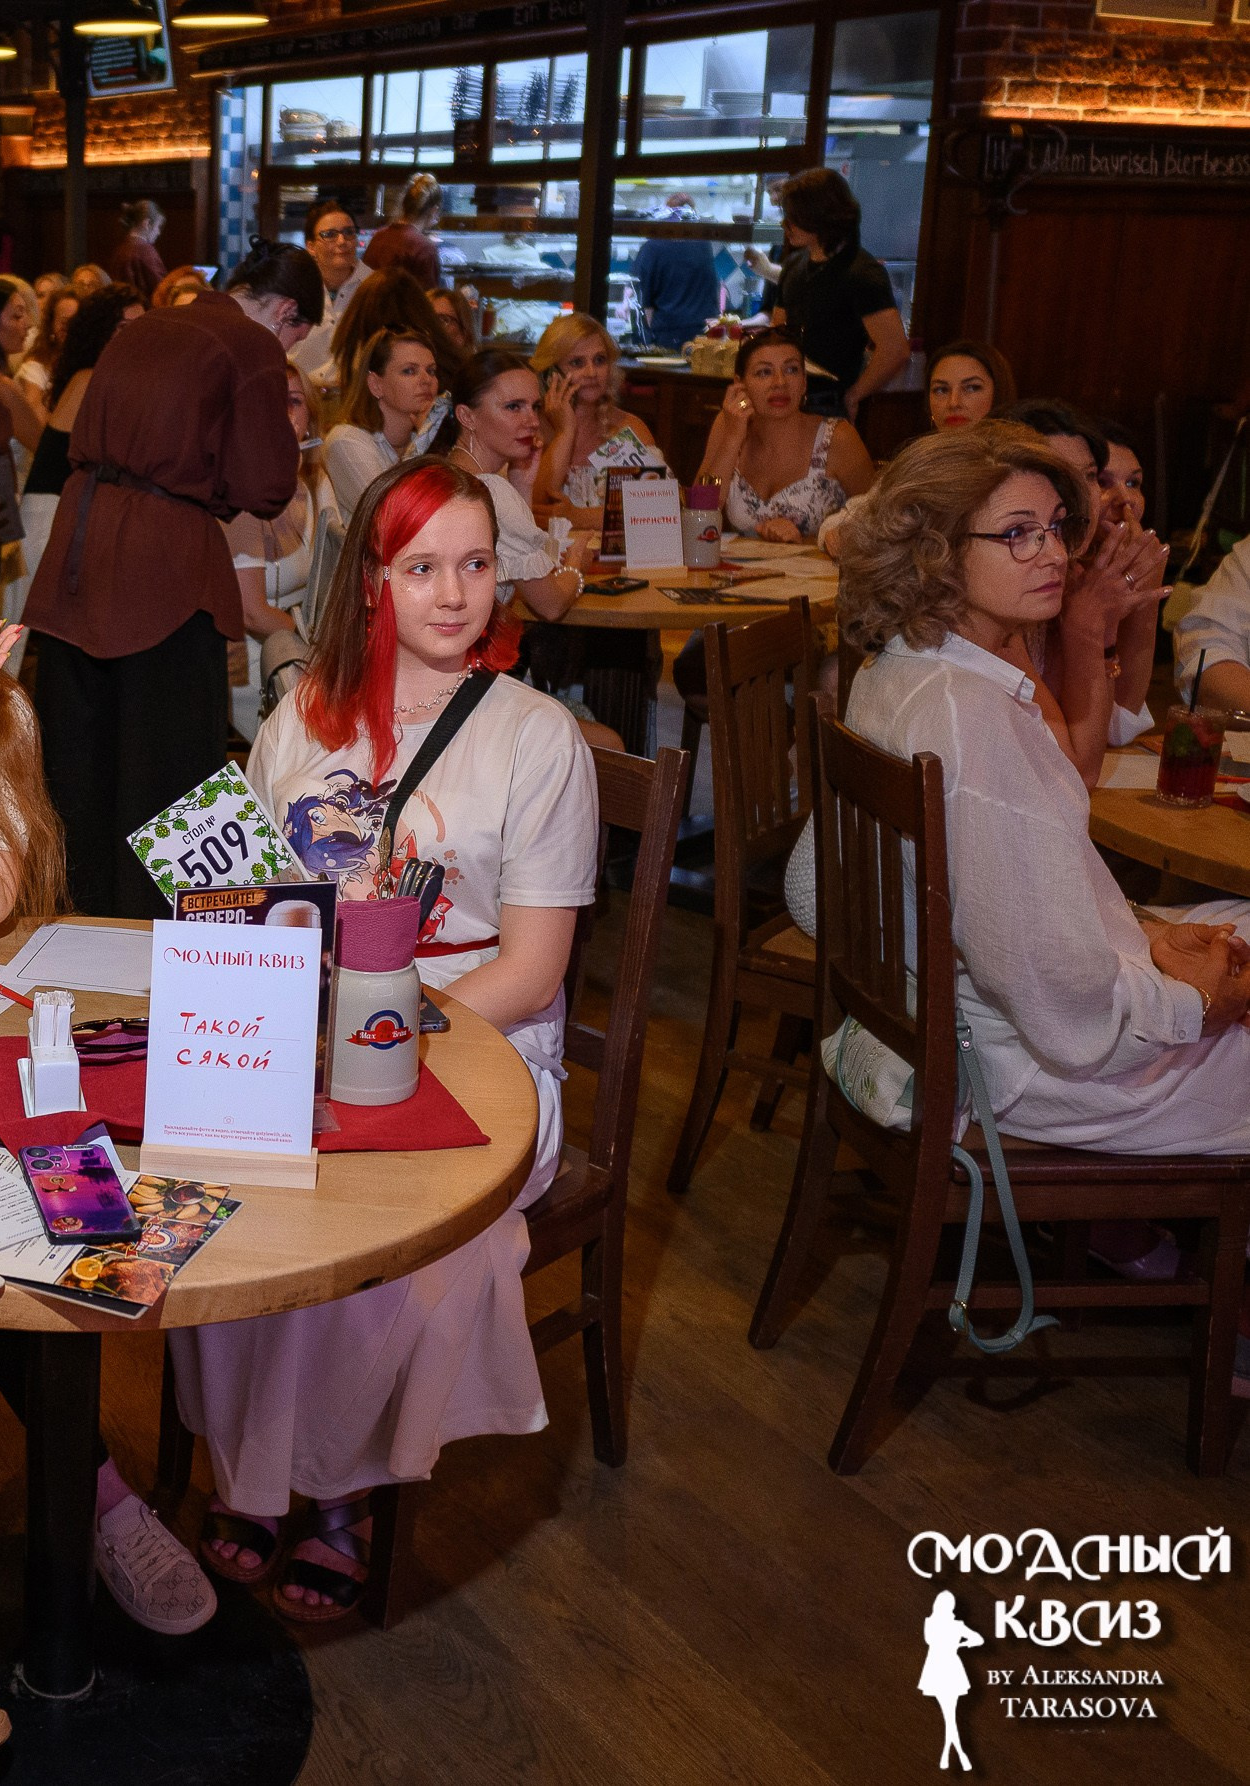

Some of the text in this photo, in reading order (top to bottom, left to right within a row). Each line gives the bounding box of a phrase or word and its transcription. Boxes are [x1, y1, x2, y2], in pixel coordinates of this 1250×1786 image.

[182, 825, 207, 845] СТОЛ
[177, 820, 249, 887] 509
[187, 892, 255, 909] ВСТРЕЧАЙТЕ!
[163, 947, 305, 969] МОДНЫЙ КВИЗ
[359, 1031, 376, 1040] Max
